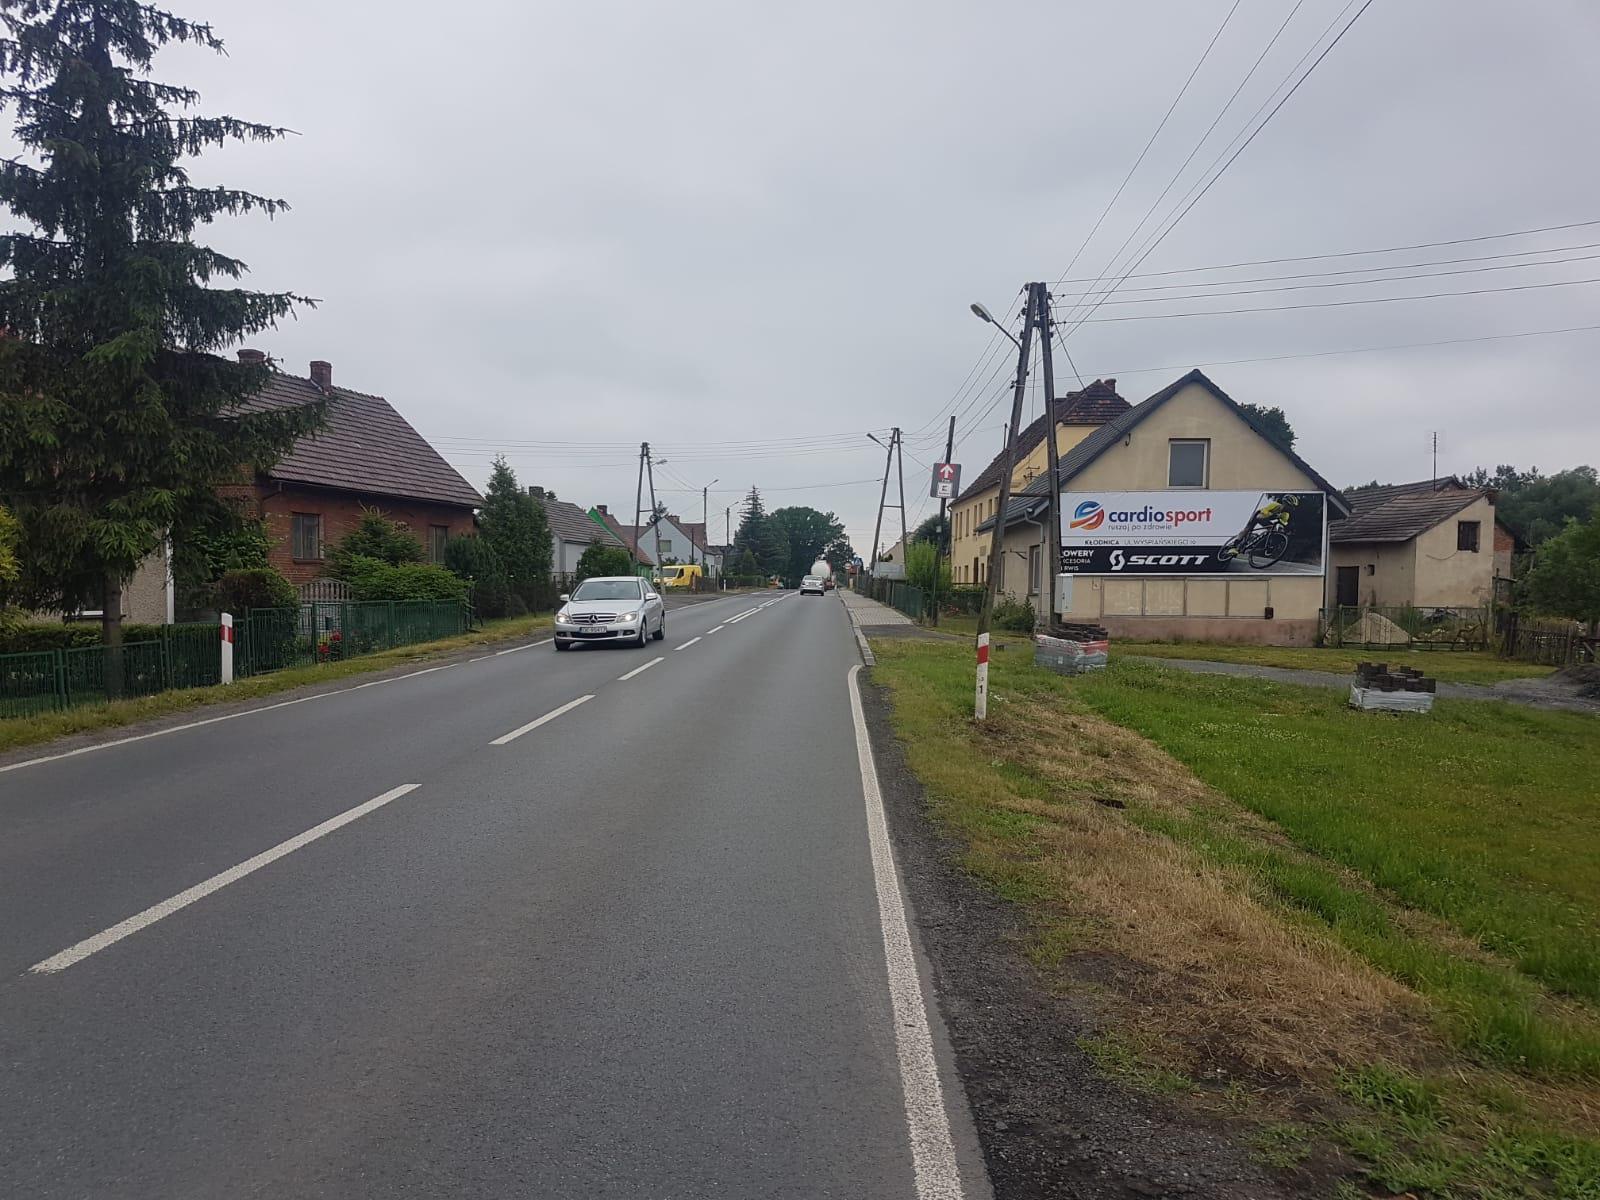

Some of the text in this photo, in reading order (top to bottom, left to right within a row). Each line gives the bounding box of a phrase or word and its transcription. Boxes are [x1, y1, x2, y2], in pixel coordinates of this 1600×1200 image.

[1109, 506, 1212, 527] cardiosport
[1108, 524, 1130, 532] ruszaj
[1127, 555, 1210, 565] SCOTT
